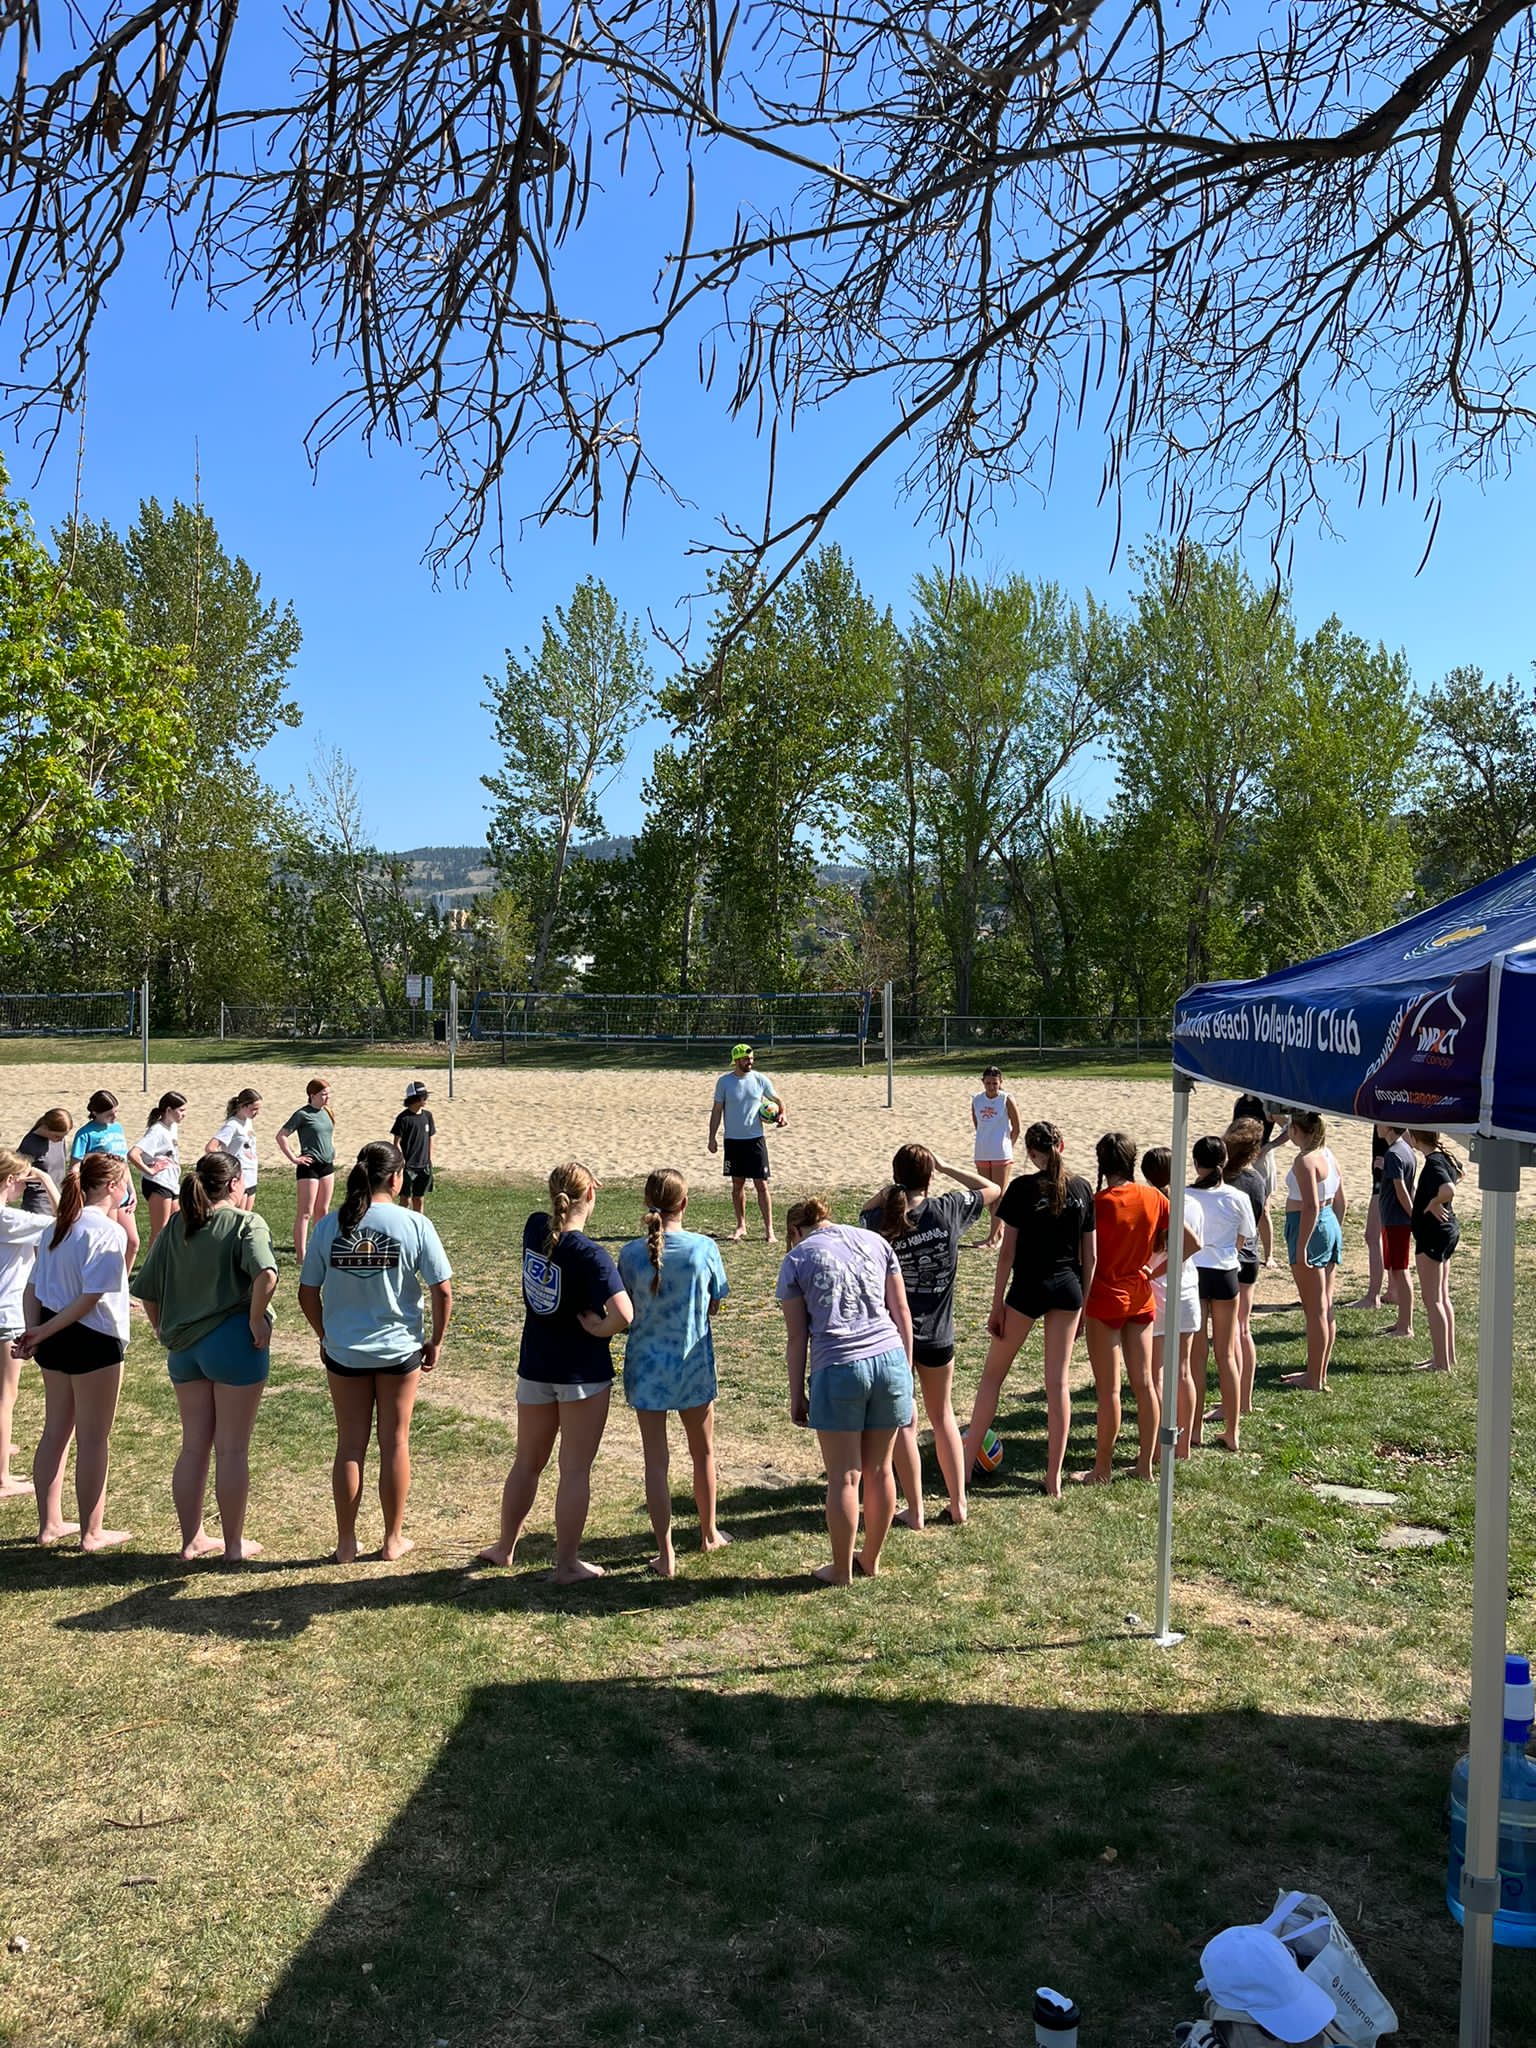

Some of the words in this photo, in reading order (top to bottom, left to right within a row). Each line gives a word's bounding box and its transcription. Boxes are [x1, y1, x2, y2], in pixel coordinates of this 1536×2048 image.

[1212, 1005, 1249, 1041] Beach
[1252, 1003, 1316, 1053] Volleyball
[1317, 1008, 1361, 1056] Club
[1337, 1984, 1375, 2030] lululemon
